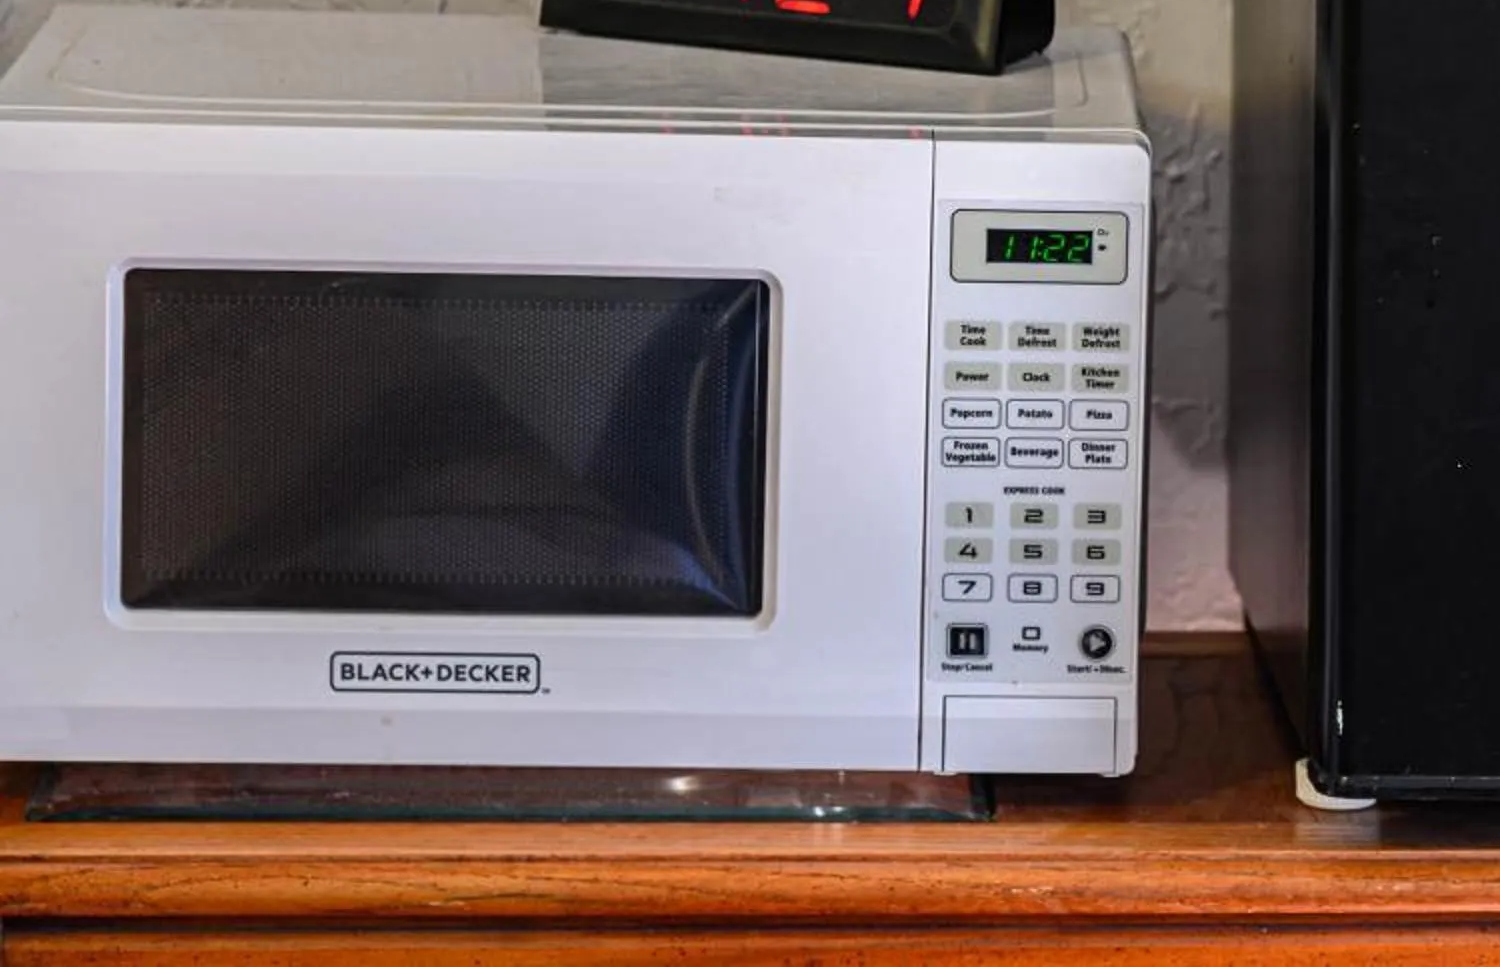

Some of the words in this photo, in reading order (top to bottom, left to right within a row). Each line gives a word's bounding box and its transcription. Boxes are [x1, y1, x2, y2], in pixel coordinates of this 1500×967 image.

[1004, 234, 1090, 261] 11:22
[960, 325, 986, 335] Time
[1025, 326, 1050, 336] Time
[1083, 327, 1120, 338] Weight
[960, 337, 987, 346] Cook
[1017, 338, 1057, 348] Defrost
[1081, 338, 1121, 348] Defrost
[955, 372, 989, 382] Power
[1022, 373, 1051, 382] Clock
[1081, 367, 1120, 378] Kitchen
[1085, 379, 1115, 389] Timer
[950, 409, 993, 420] Popcorn
[1017, 409, 1053, 419] Potato
[1086, 411, 1113, 420] Pizza
[953, 441, 989, 450] Frozen
[1081, 443, 1116, 452] Dinner
[1010, 447, 1060, 458] Beverage
[945, 453, 997, 464] Vegetable
[1085, 454, 1112, 464] Plate
[1003, 486, 1039, 495] EXPRESS
[966, 508, 973, 523] 1
[1024, 508, 1044, 524] 2
[1087, 509, 1107, 524] 3
[958, 543, 978, 559] 4
[1023, 544, 1043, 559] 5
[1086, 545, 1106, 560] 6
[958, 580, 977, 595] 7
[1023, 581, 1042, 595] 8
[1086, 582, 1105, 596] 9
[1021, 626, 1041, 640] 0
[1012, 643, 1049, 654] Memory
[339, 663, 531, 683] BLACK+DECKER
